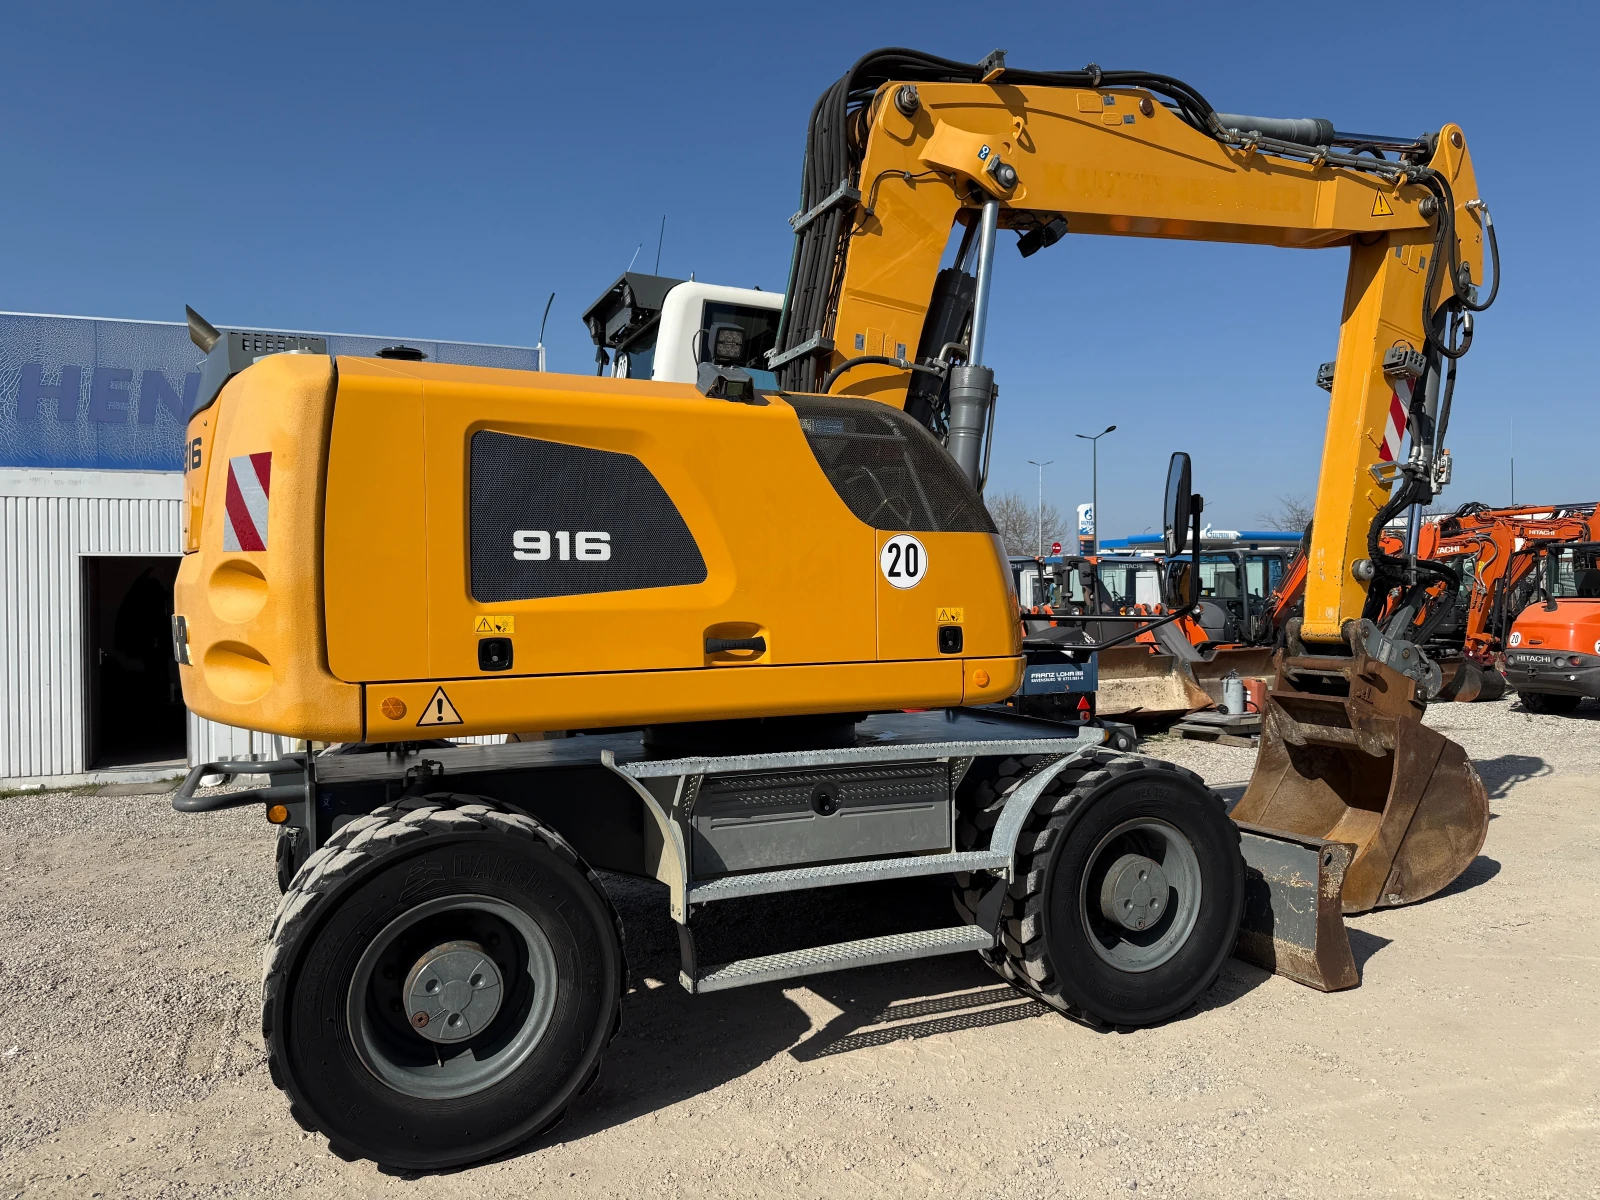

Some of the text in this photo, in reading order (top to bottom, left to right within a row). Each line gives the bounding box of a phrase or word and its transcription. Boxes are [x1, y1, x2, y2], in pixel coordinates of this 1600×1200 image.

[512, 530, 611, 561] 916
[887, 543, 918, 577] 20
[1511, 634, 1520, 644] 20
[1516, 655, 1551, 663] HITACHI
[1132, 787, 1151, 799] WEX
[453, 853, 551, 898] CAMSO
